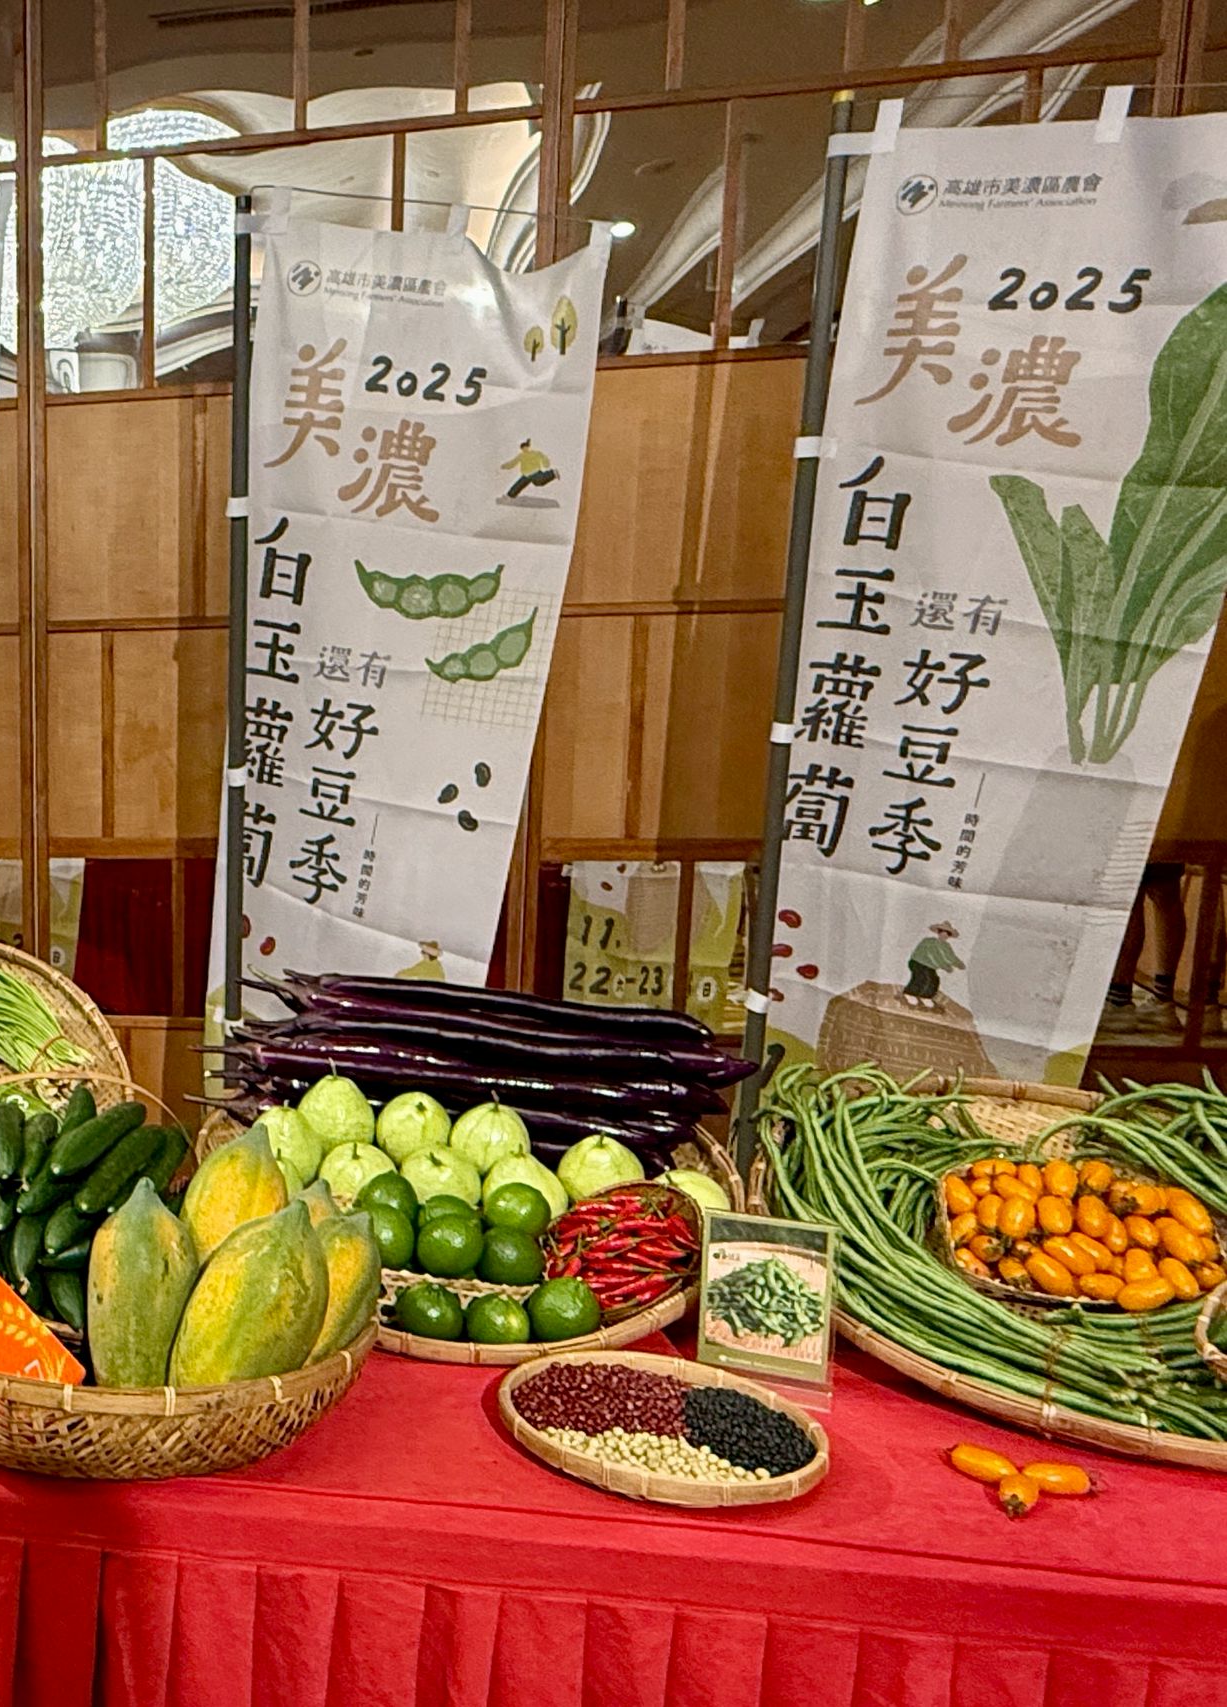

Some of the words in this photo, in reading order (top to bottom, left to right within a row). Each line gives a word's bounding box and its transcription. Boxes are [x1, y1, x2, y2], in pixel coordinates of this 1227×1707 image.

[943, 173, 1102, 196] 高雄市美濃區農會
[988, 266, 1153, 314] 2025
[365, 355, 487, 406] 2025
[854, 253, 1082, 448] 美濃
[263, 338, 440, 522] 美濃
[313, 644, 392, 689] 還有
[783, 455, 912, 858] 白玉蘿蔔
[910, 590, 1008, 637] 還有
[289, 698, 379, 904] 好豆季
[868, 648, 990, 875] 好豆季
